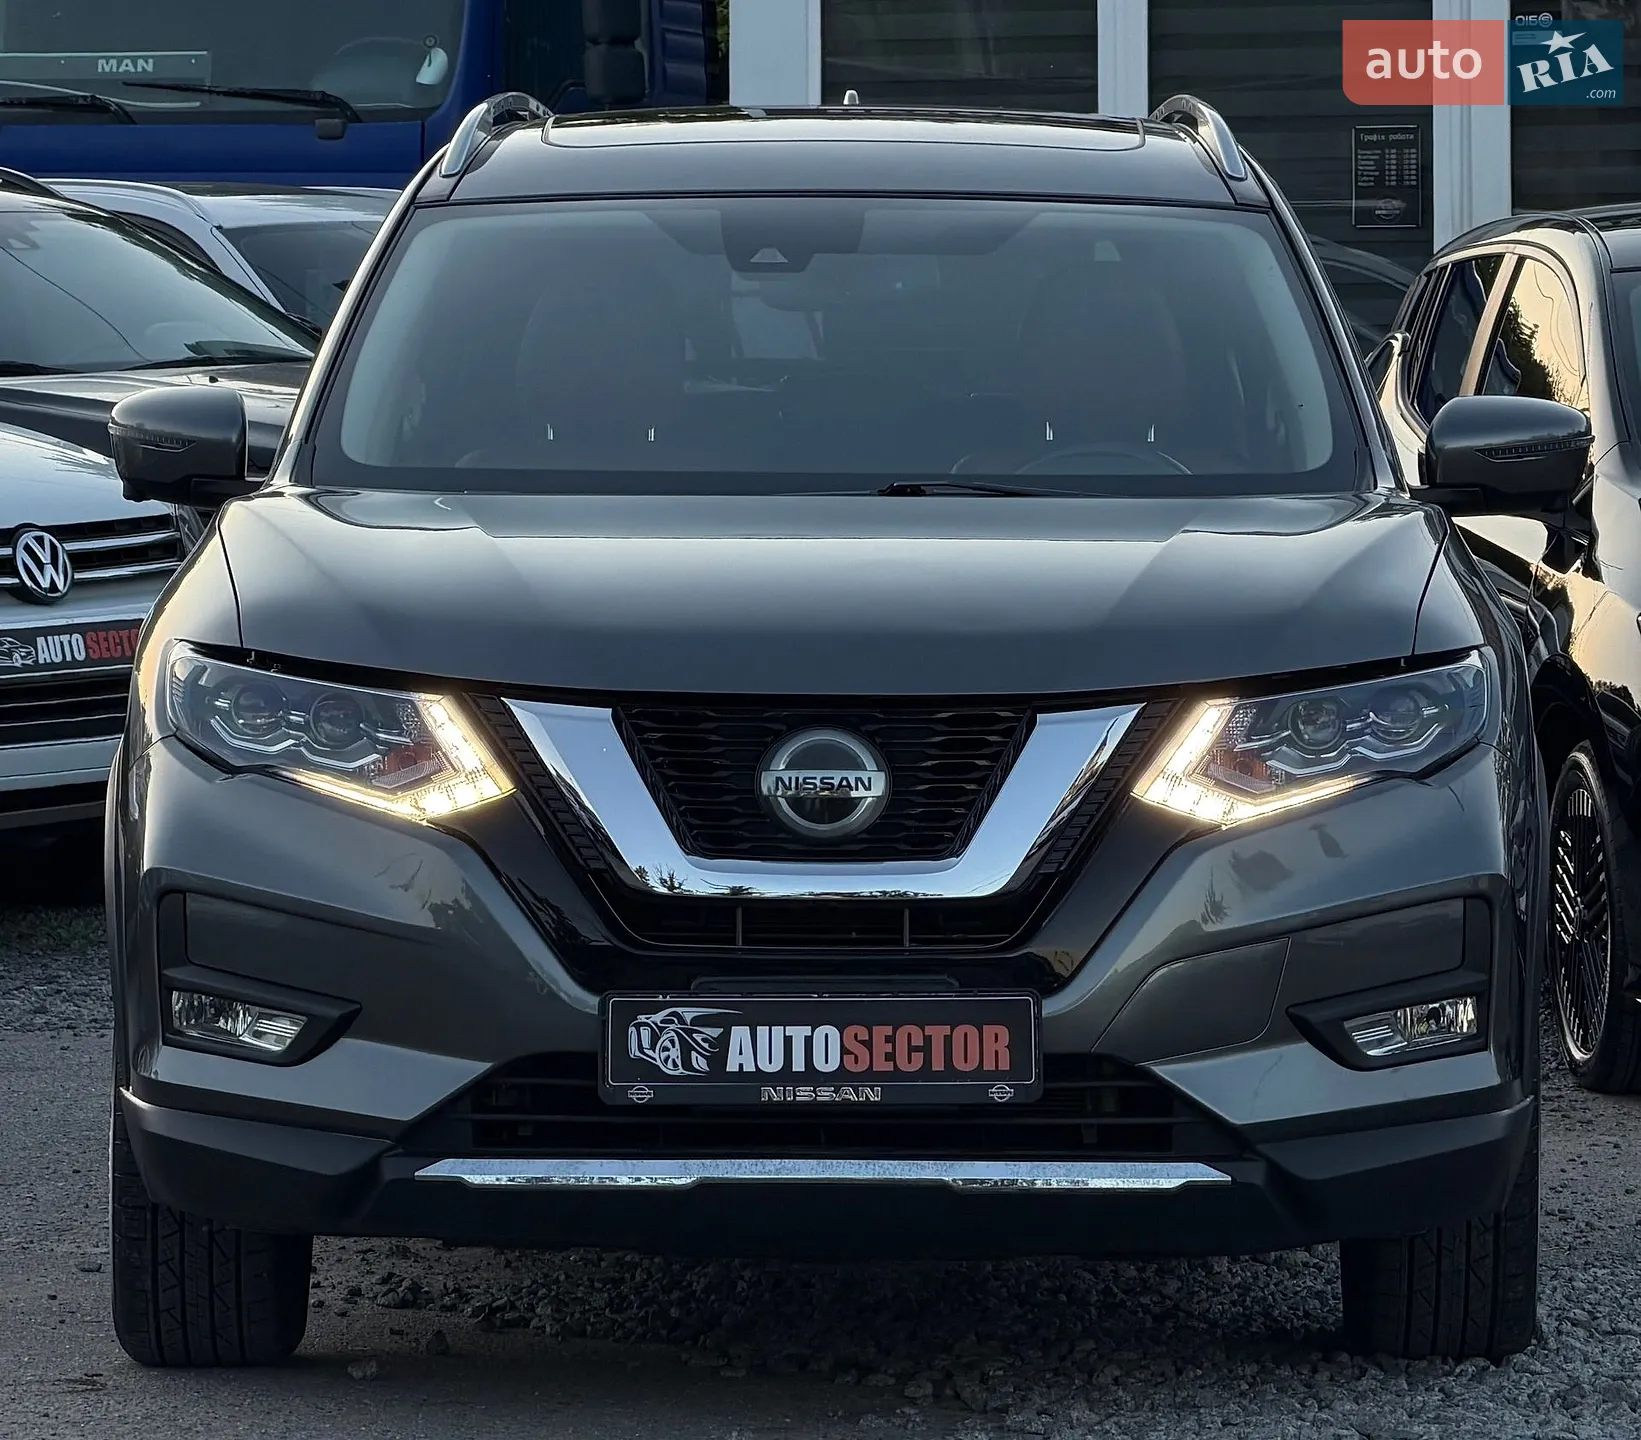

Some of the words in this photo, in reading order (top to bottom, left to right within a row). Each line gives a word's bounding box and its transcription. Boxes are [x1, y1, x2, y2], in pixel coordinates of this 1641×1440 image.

[97, 58, 154, 73] MAN
[774, 776, 872, 792] NISSAN
[761, 1086, 881, 1102] NISSAN
